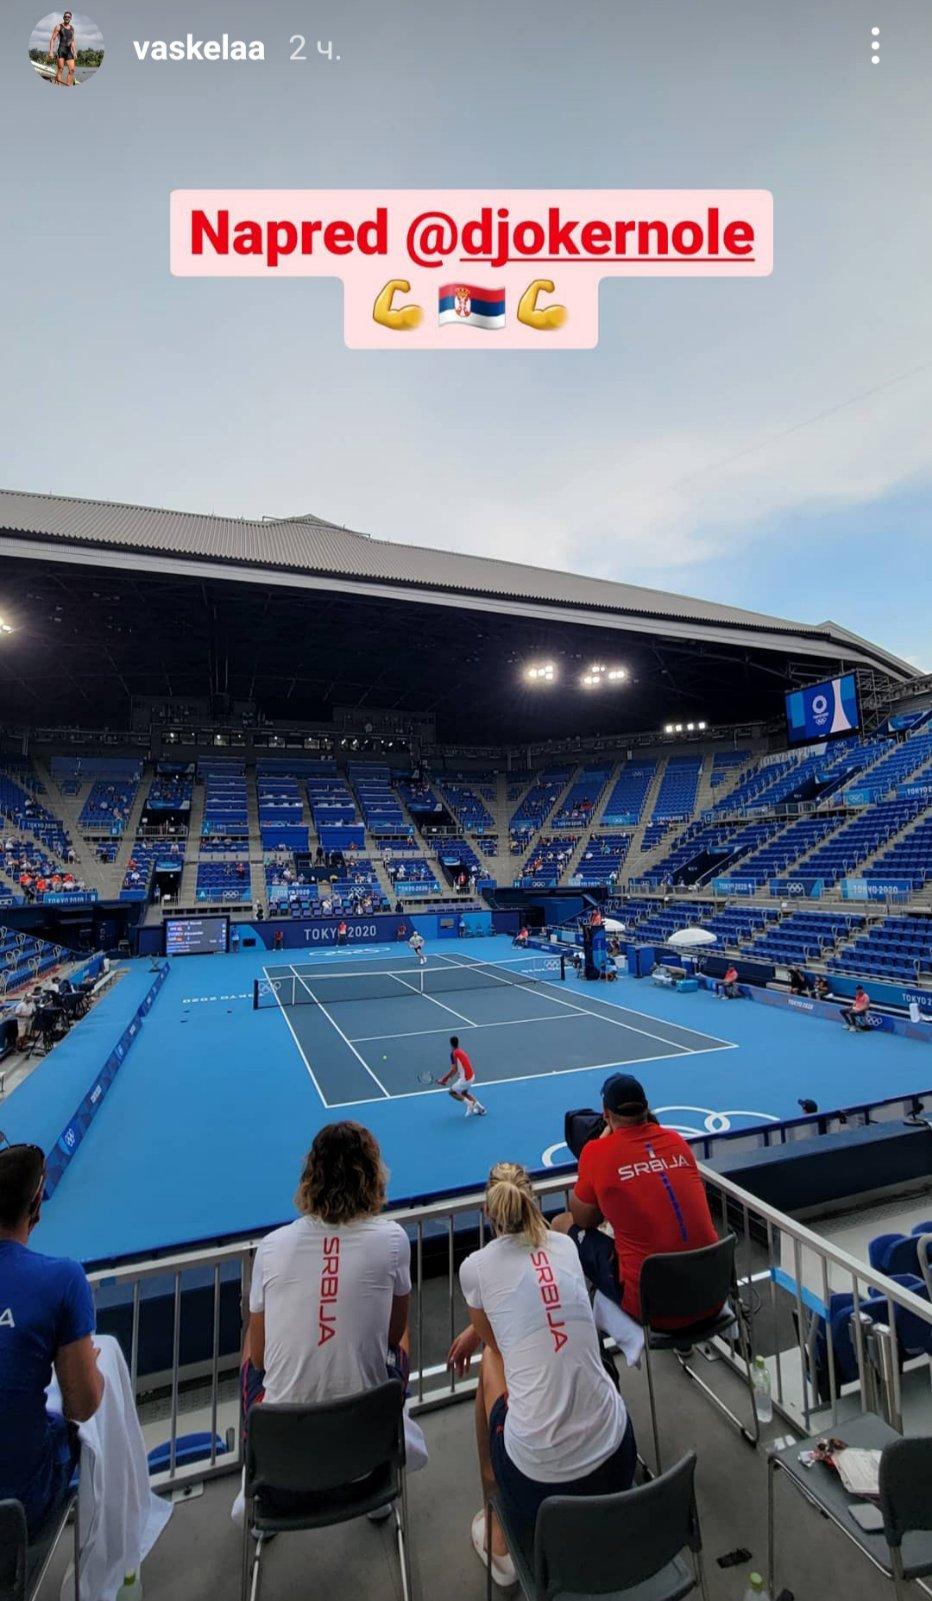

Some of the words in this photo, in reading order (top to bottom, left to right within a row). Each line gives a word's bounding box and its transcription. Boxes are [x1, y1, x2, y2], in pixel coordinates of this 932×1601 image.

[304, 927, 337, 941] TOKY
[347, 925, 377, 938] 2020
[618, 1154, 690, 1181] SRBIJA
[318, 1236, 340, 1347] SRBIJA
[529, 1250, 568, 1353] SRBIJA
